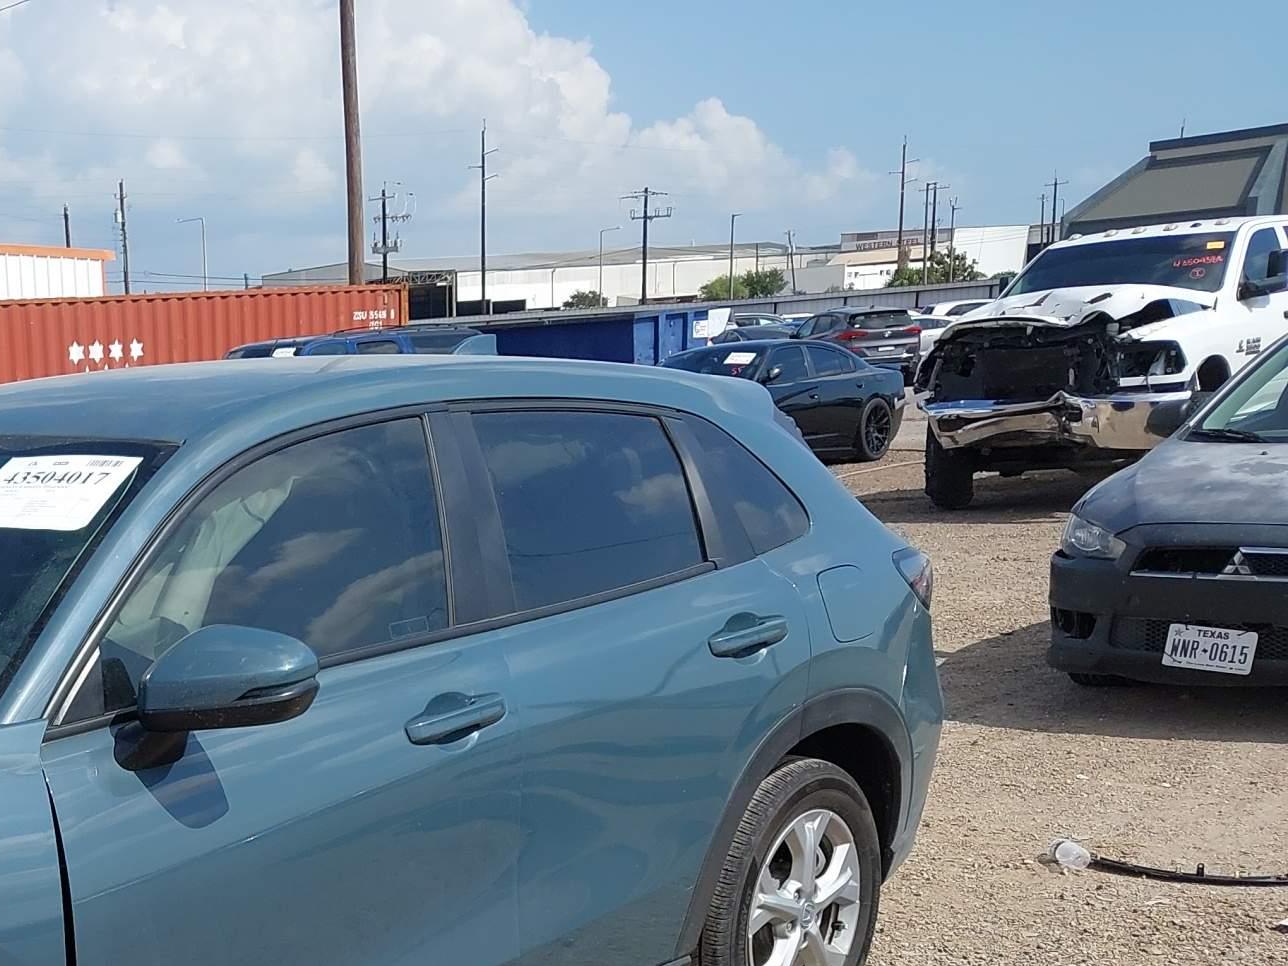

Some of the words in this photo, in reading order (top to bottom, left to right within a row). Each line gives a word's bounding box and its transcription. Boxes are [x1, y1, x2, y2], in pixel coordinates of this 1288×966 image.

[856, 240, 893, 251] WESTERN
[3, 471, 111, 485] 43504017
[1197, 629, 1230, 640] TEXAS
